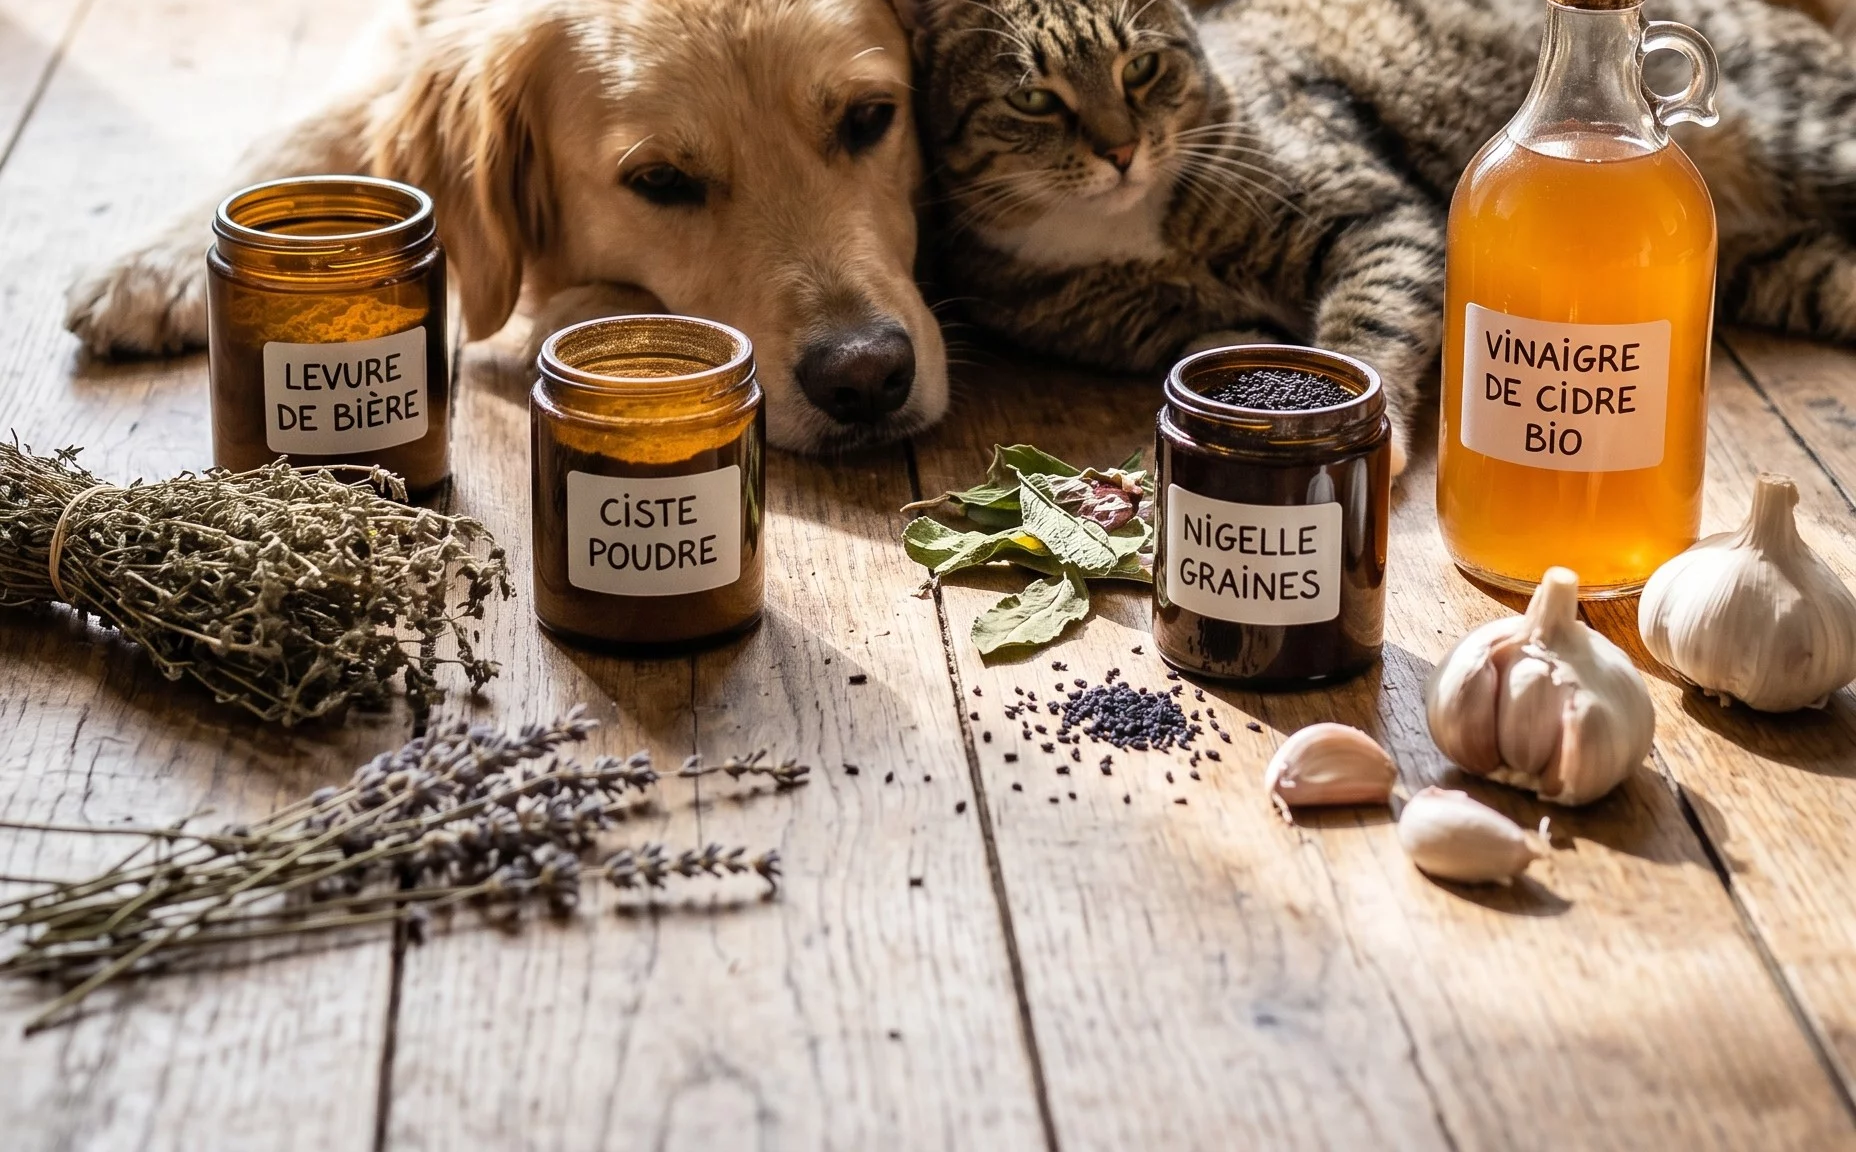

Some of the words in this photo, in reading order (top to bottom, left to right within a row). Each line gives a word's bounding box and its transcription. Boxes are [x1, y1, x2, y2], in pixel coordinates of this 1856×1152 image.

[285, 353, 402, 391] LEVURE
[1485, 373, 1522, 408] DE
[276, 402, 319, 432] DE
[588, 534, 718, 572] POUDRE
